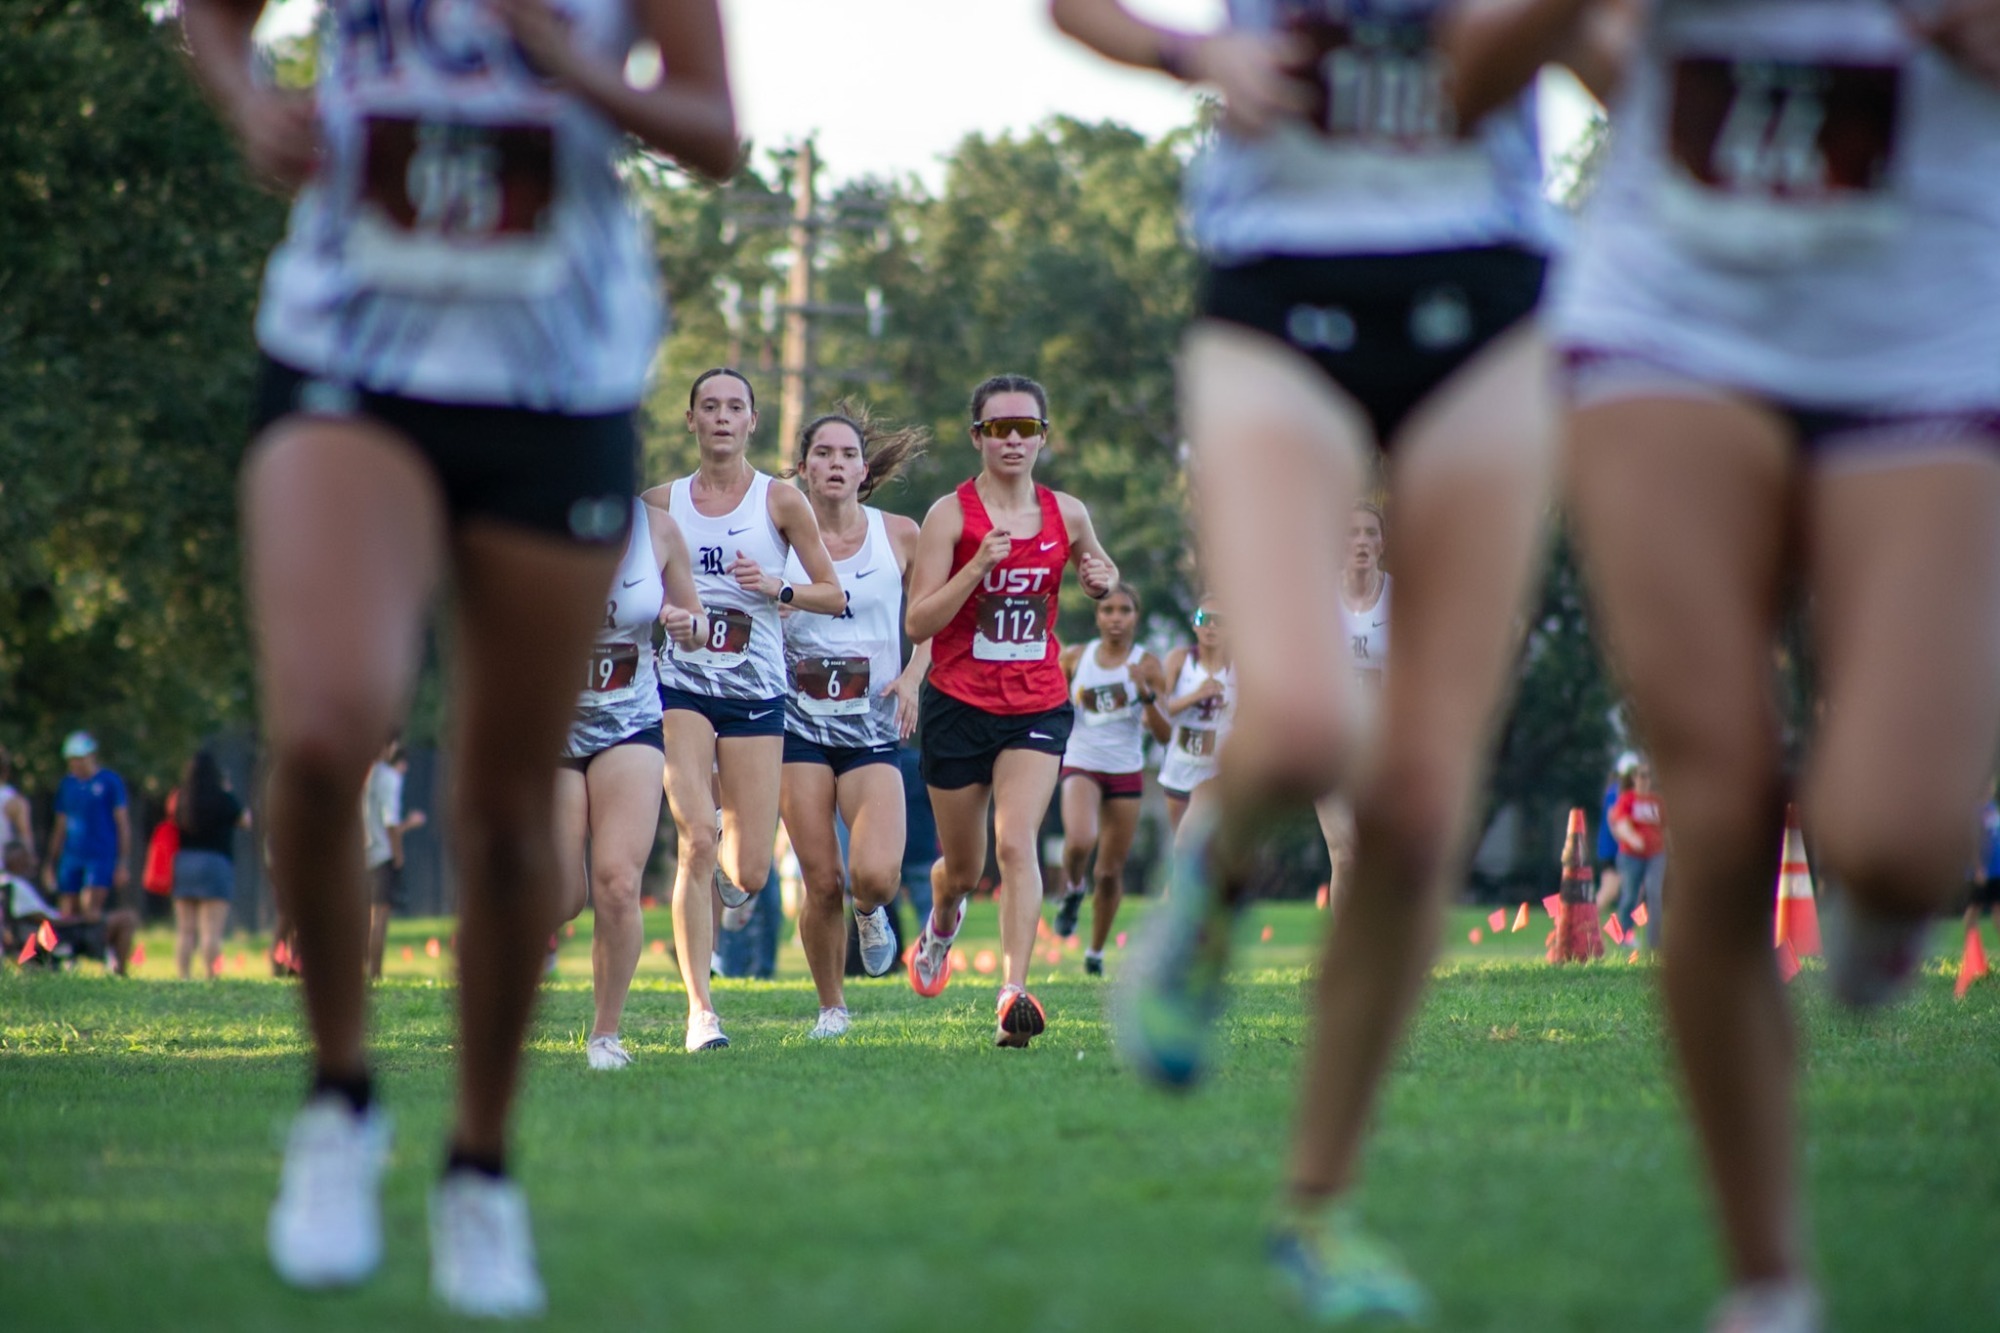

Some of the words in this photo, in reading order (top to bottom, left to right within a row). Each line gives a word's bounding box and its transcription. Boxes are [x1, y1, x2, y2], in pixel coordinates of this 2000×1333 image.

[699, 546, 725, 576] R
[983, 567, 1050, 593] UST
[712, 620, 727, 649] 8
[994, 610, 1036, 640] 112
[827, 670, 841, 698] 6
